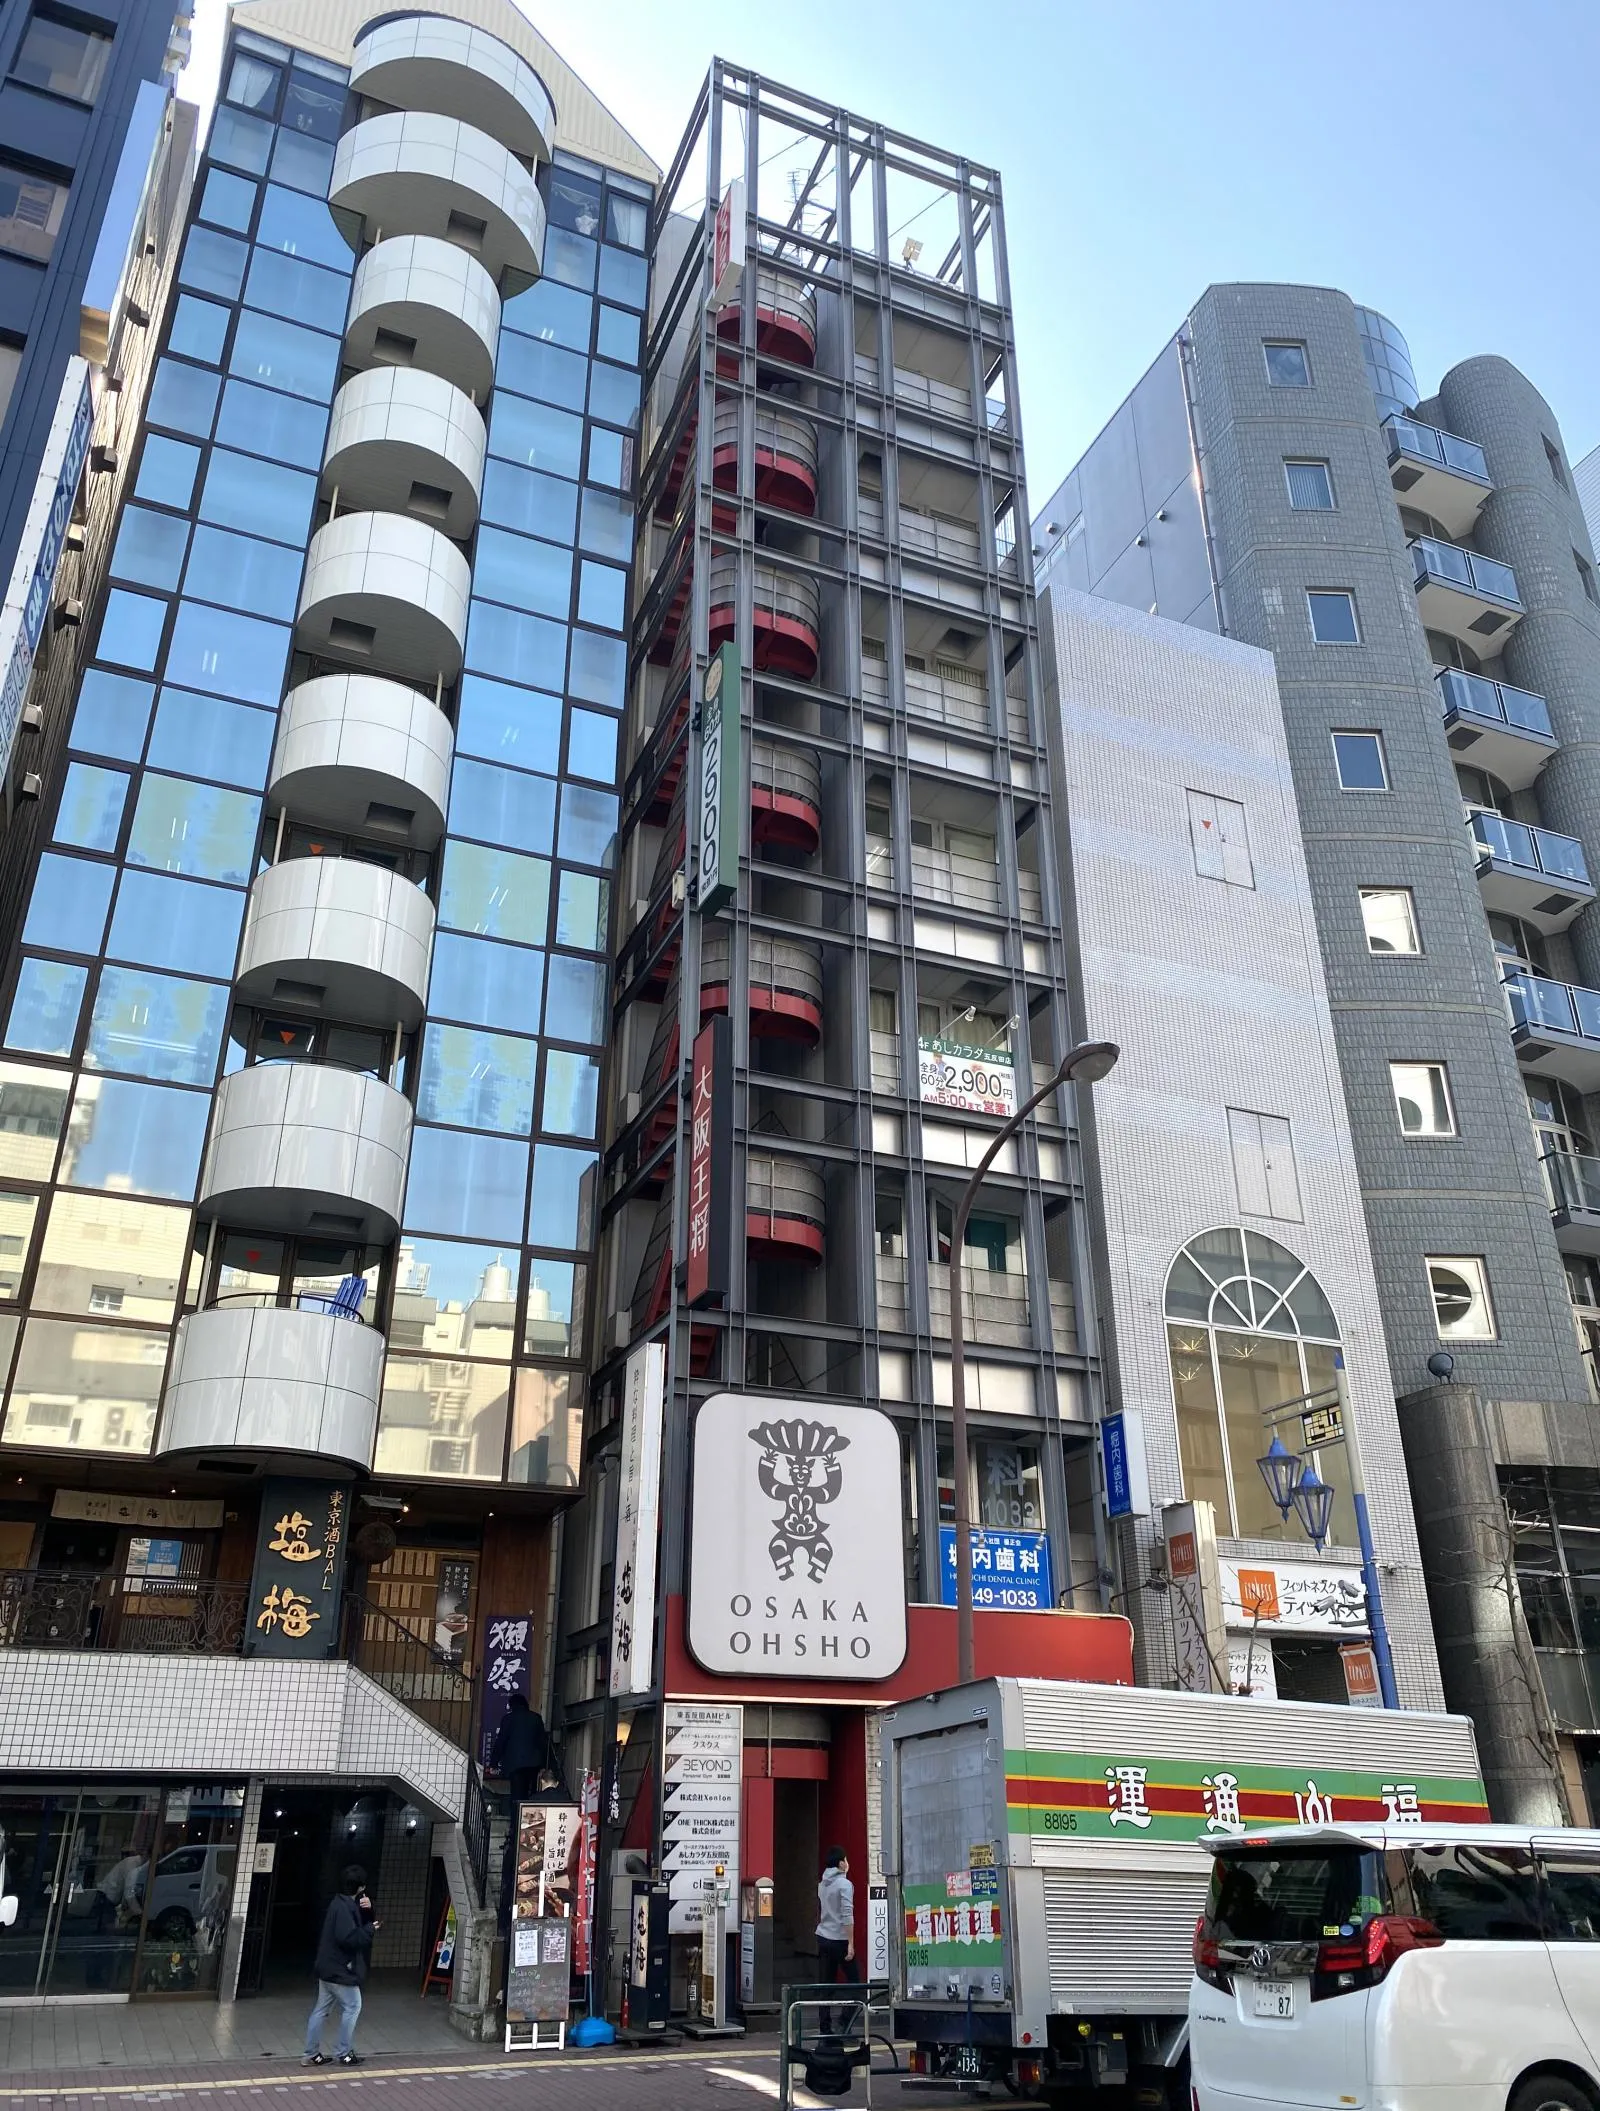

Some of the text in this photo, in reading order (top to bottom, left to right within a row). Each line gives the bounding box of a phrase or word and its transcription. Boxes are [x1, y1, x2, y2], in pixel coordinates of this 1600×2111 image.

[703, 737, 718, 878] 2900
[918, 1037, 1012, 1065] 4F あしカラダ 五反田店
[920, 1062, 938, 1074] 全身
[921, 1073, 945, 1088] 60分
[690, 1065, 712, 1257] 大阪王将
[322, 1490, 344, 1590] 東京酒BAL
[257, 1511, 322, 1637] 塩梅
[988, 1576, 1014, 1584] DENTAL
[1016, 1578, 1040, 1586] CLINIC
[730, 1594, 869, 1622] OSAKA
[729, 1631, 871, 1659] OHSHO
[693, 1741, 720, 1749] クスクス
[683, 1759, 732, 1771] BEYOND
[1044, 1813, 1078, 1831] 88195
[664, 1842, 673, 1850] 4F
[663, 1872, 672, 1880] 3F
[875, 1889, 886, 1899] 7F
[916, 1900, 995, 1946] 福山通運
[875, 1906, 886, 1971] BEYOND
[909, 1950, 929, 1966] 88195
[1279, 1997, 1291, 2015] 87
